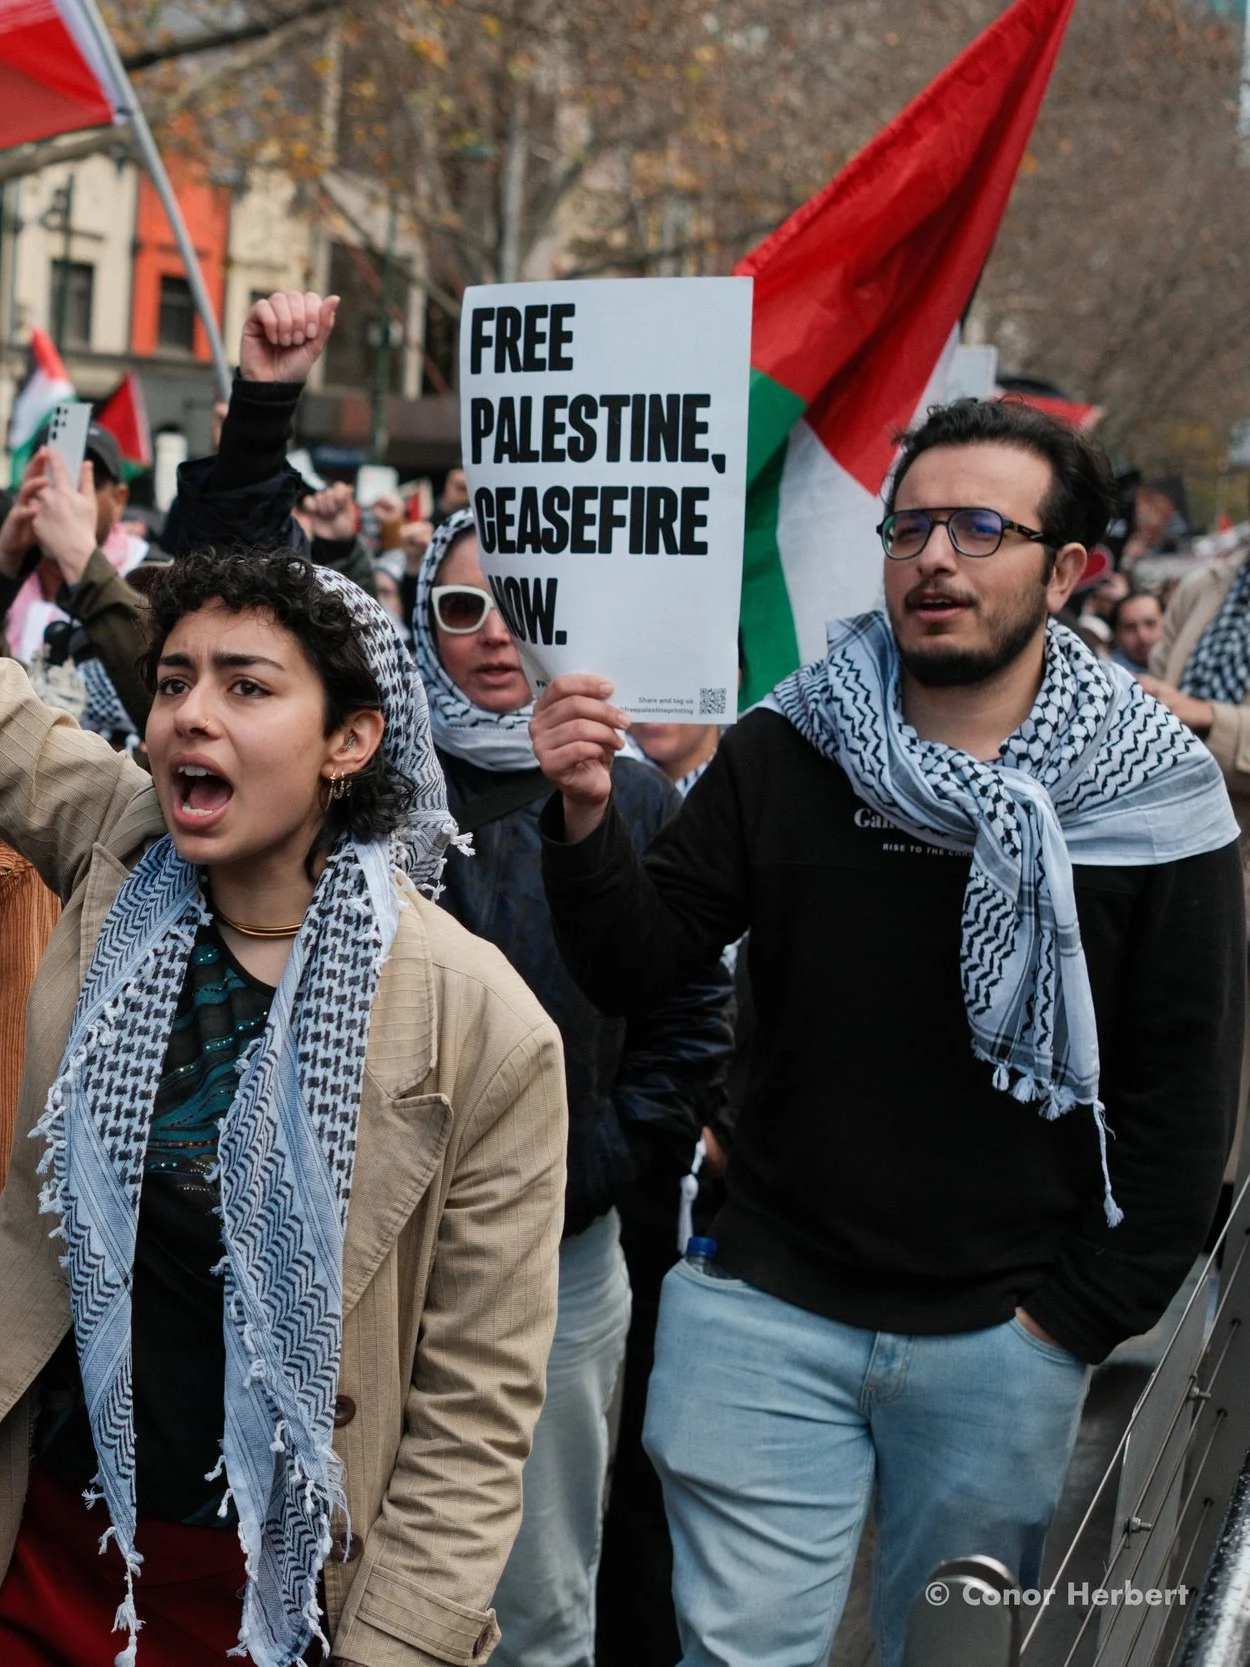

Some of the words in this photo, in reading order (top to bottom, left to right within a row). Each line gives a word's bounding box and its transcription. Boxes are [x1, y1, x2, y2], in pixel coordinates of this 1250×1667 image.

[470, 303, 576, 375] FREE
[470, 393, 726, 474] PALESTINE,
[474, 485, 710, 556] CEASEFIRE
[638, 696, 657, 704] Share
[673, 698, 684, 706] tag
[882, 843, 905, 852] RISE
[910, 845, 923, 854] TO
[926, 846, 944, 856] THE
